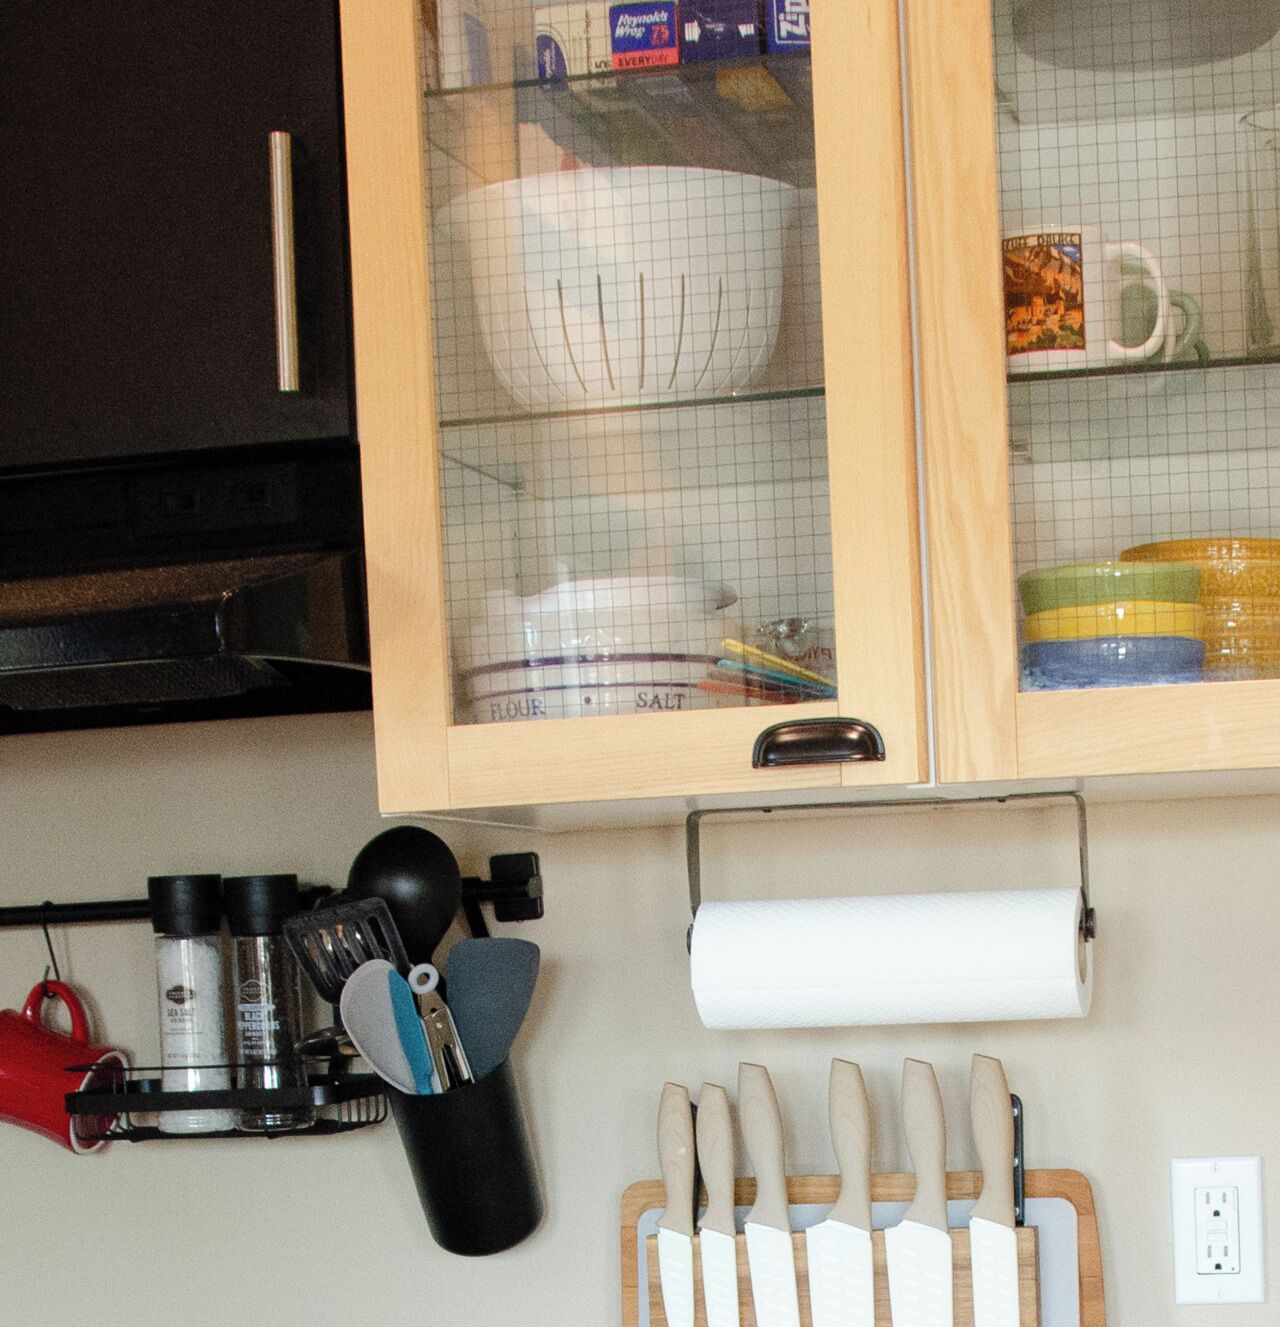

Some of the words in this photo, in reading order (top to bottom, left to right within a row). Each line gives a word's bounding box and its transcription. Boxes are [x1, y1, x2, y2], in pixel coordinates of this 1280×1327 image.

[617, 10, 669, 27] Reynolds
[614, 26, 646, 39] Wrap
[489, 699, 547, 720] FLOUR
[636, 692, 687, 710] SALT
